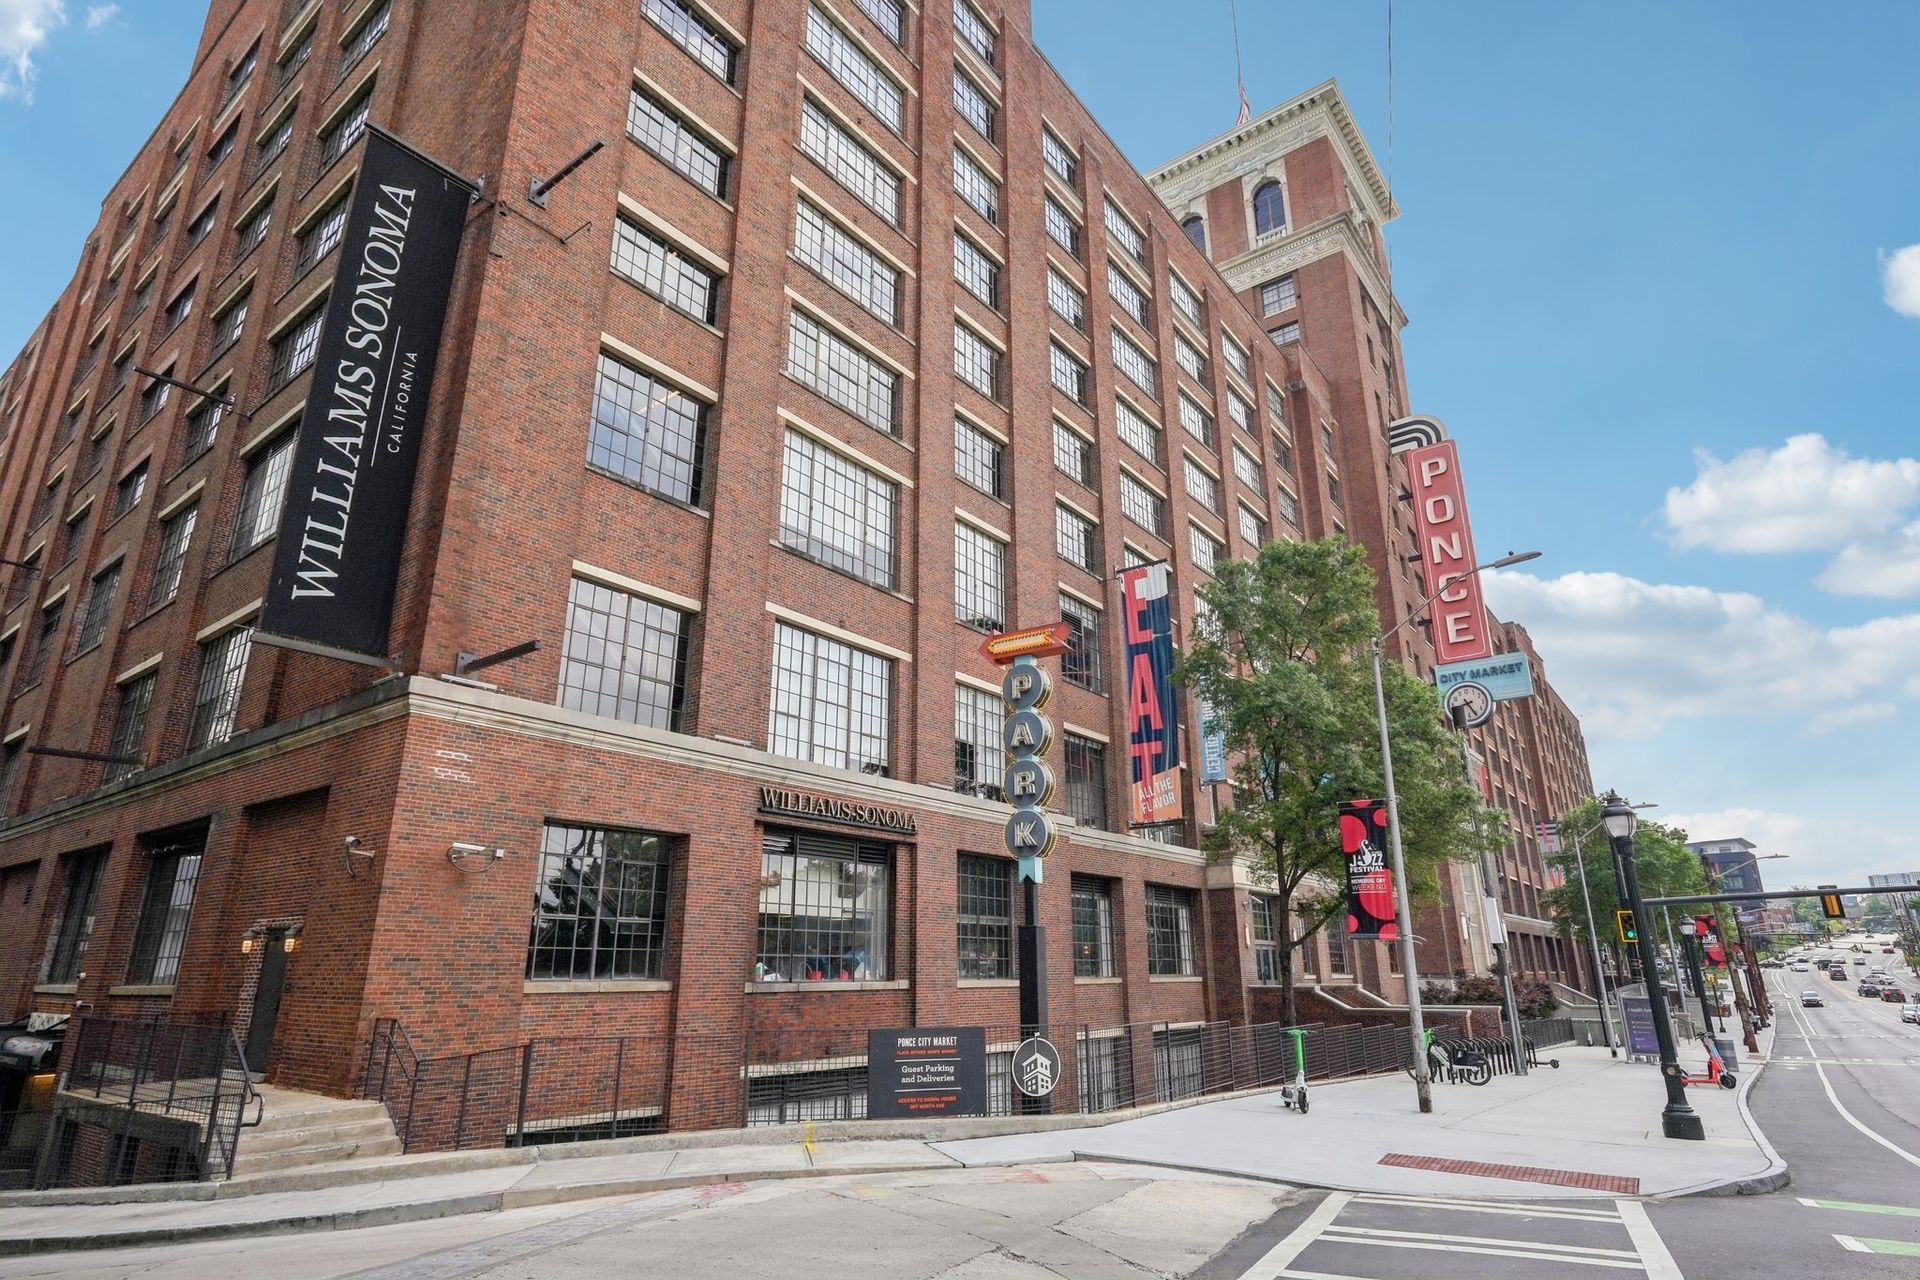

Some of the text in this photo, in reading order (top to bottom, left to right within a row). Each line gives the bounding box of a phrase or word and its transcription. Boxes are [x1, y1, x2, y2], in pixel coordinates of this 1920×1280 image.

[291, 183, 416, 600] WILLIAMS SONOMA
[388, 351, 418, 454] CALIFORNIA
[1420, 456, 1475, 645] PONCE
[1440, 662, 1523, 684] CITY MARKET
[1124, 567, 1163, 820] EAT
[1010, 674, 1037, 847] PARK
[1138, 777, 1173, 801] ALL THE
[1141, 792, 1176, 814] FLAVOR
[760, 786, 918, 830] WILLIAMS-SONOMA
[897, 1036, 958, 1048] PONCE CITY MARKET
[901, 1064, 955, 1074] Guest Parking
[901, 1074, 955, 1083] and Deliveries
